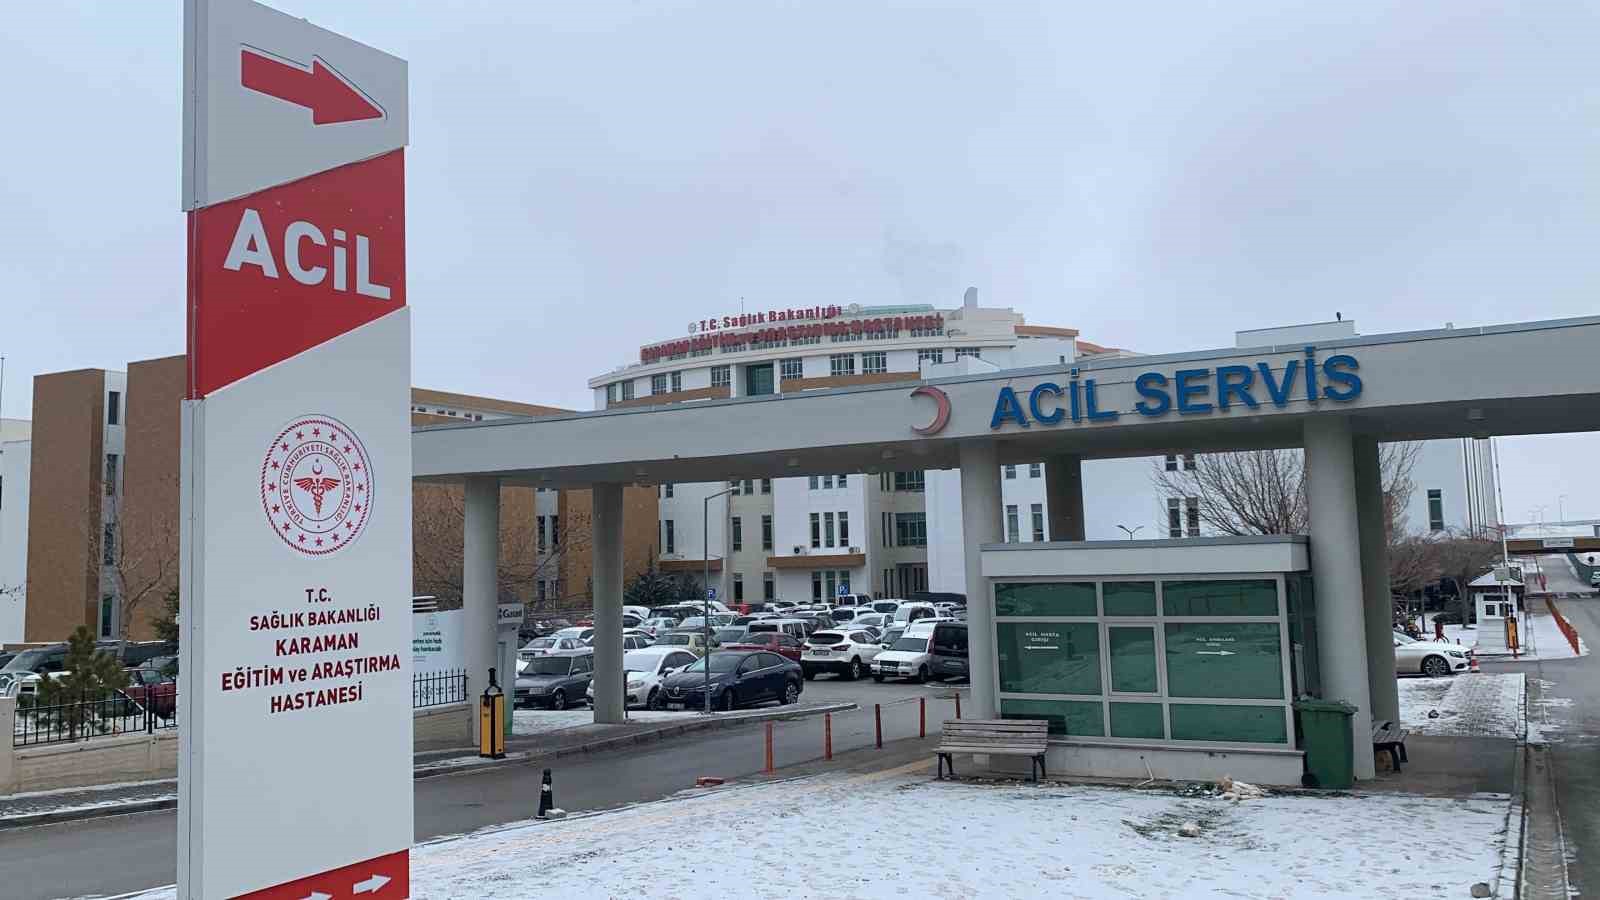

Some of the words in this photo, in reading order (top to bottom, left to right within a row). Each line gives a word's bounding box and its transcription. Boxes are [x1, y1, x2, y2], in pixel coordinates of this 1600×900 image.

[723, 311, 765, 328] Sağlık
[768, 304, 842, 322] Bakanlığı
[990, 368, 1120, 430] ACİL
[1135, 346, 1363, 417] SERVİS
[305, 588, 332, 603] T.C.
[250, 611, 304, 631] SAĞLIK
[308, 603, 380, 625] BAKANLIĞI
[275, 632, 359, 656] KARAMAN
[222, 665, 284, 691] EĞİTİM
[288, 668, 308, 682] ve
[311, 653, 401, 680] ARAŞTIRMA
[270, 680, 363, 713] HASTANESİ
